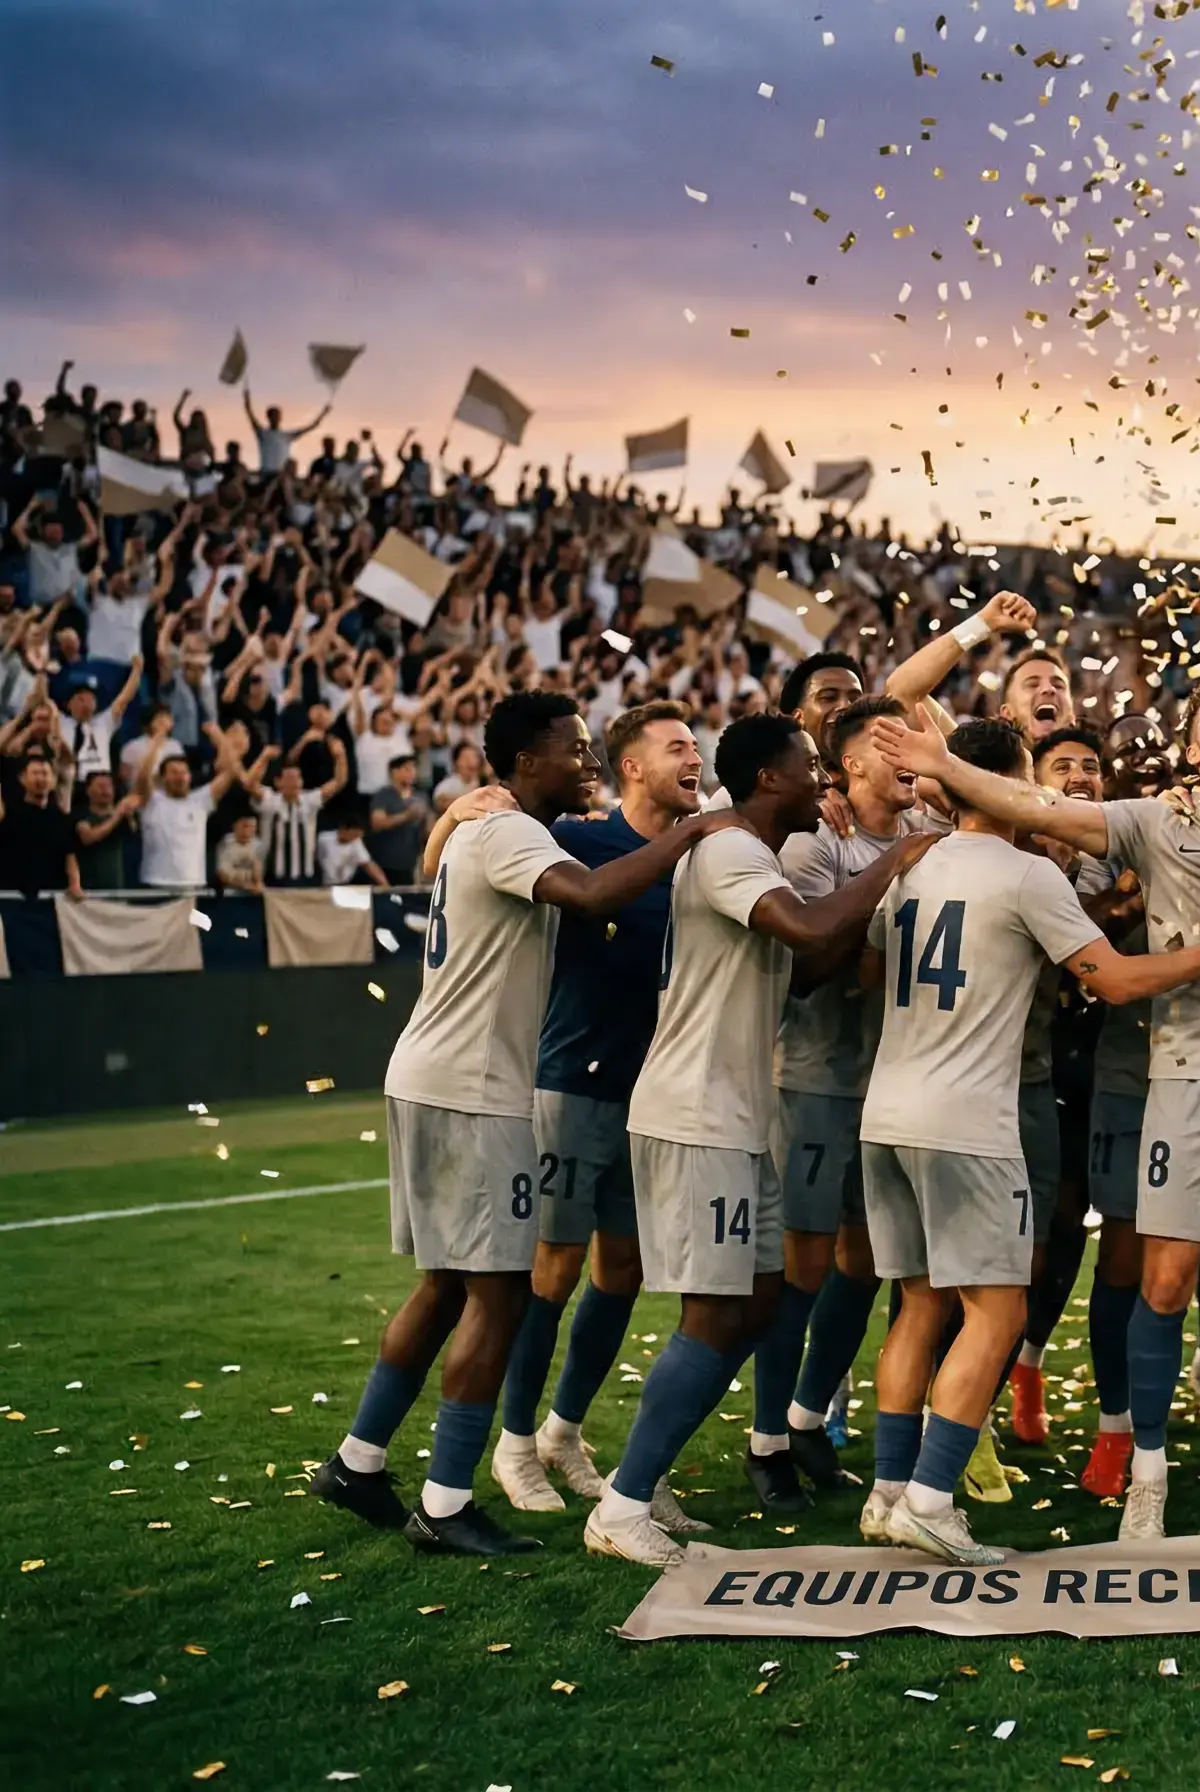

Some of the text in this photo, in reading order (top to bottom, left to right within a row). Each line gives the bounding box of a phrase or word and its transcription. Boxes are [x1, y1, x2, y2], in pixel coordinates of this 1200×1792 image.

[894, 898, 967, 1011] 14
[539, 1152, 578, 1200] 21
[802, 1143, 825, 1186] 7
[1148, 1140, 1170, 1187] 8
[512, 1173, 532, 1219] 8
[1013, 1189, 1028, 1235] 7
[709, 1196, 751, 1245] 14
[703, 1569, 1019, 1608] EQUIPOS
